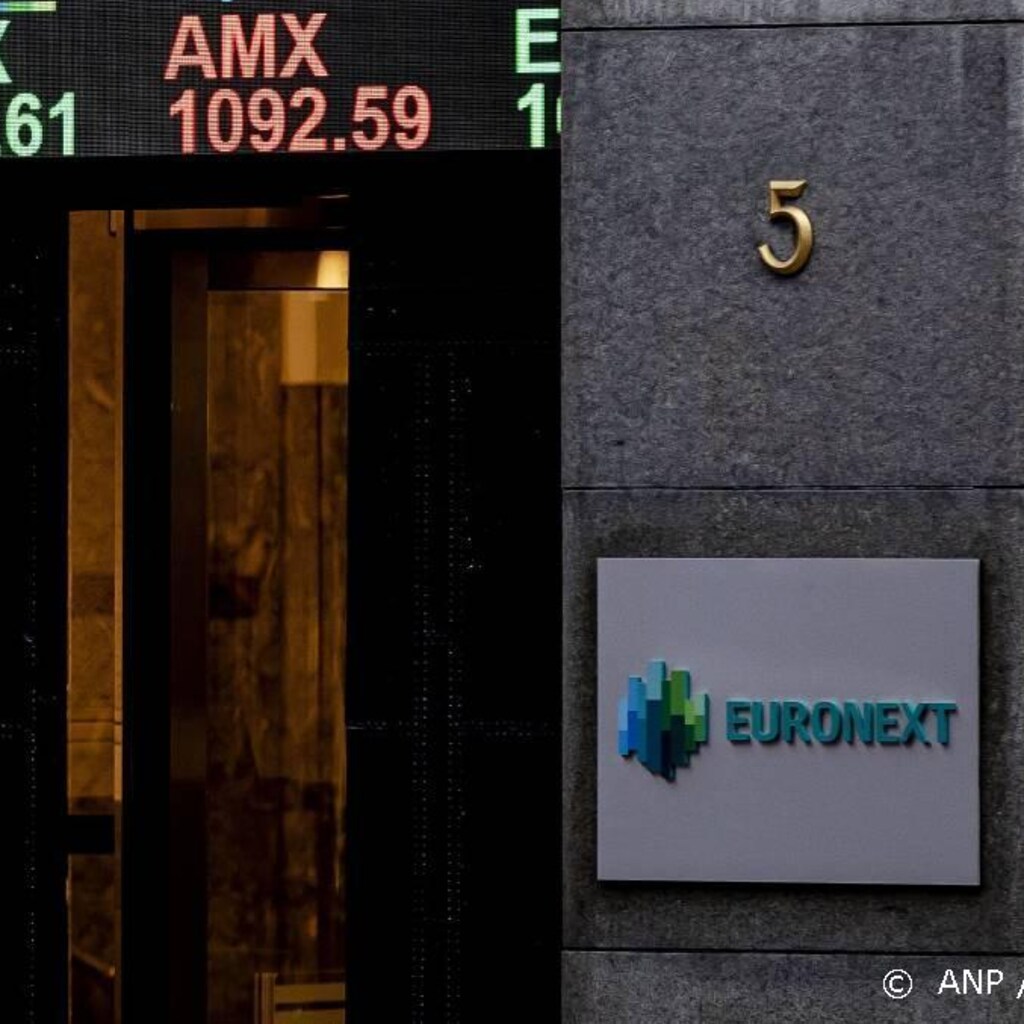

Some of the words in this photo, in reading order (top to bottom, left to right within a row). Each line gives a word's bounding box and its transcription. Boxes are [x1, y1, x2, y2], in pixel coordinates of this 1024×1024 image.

[164, 13, 329, 79] AMX
[516, 8, 562, 73] E
[169, 85, 431, 153] 1092.59
[517, 82, 562, 148] 1
[757, 179, 813, 275] 5
[726, 699, 958, 745] EURONEXT
